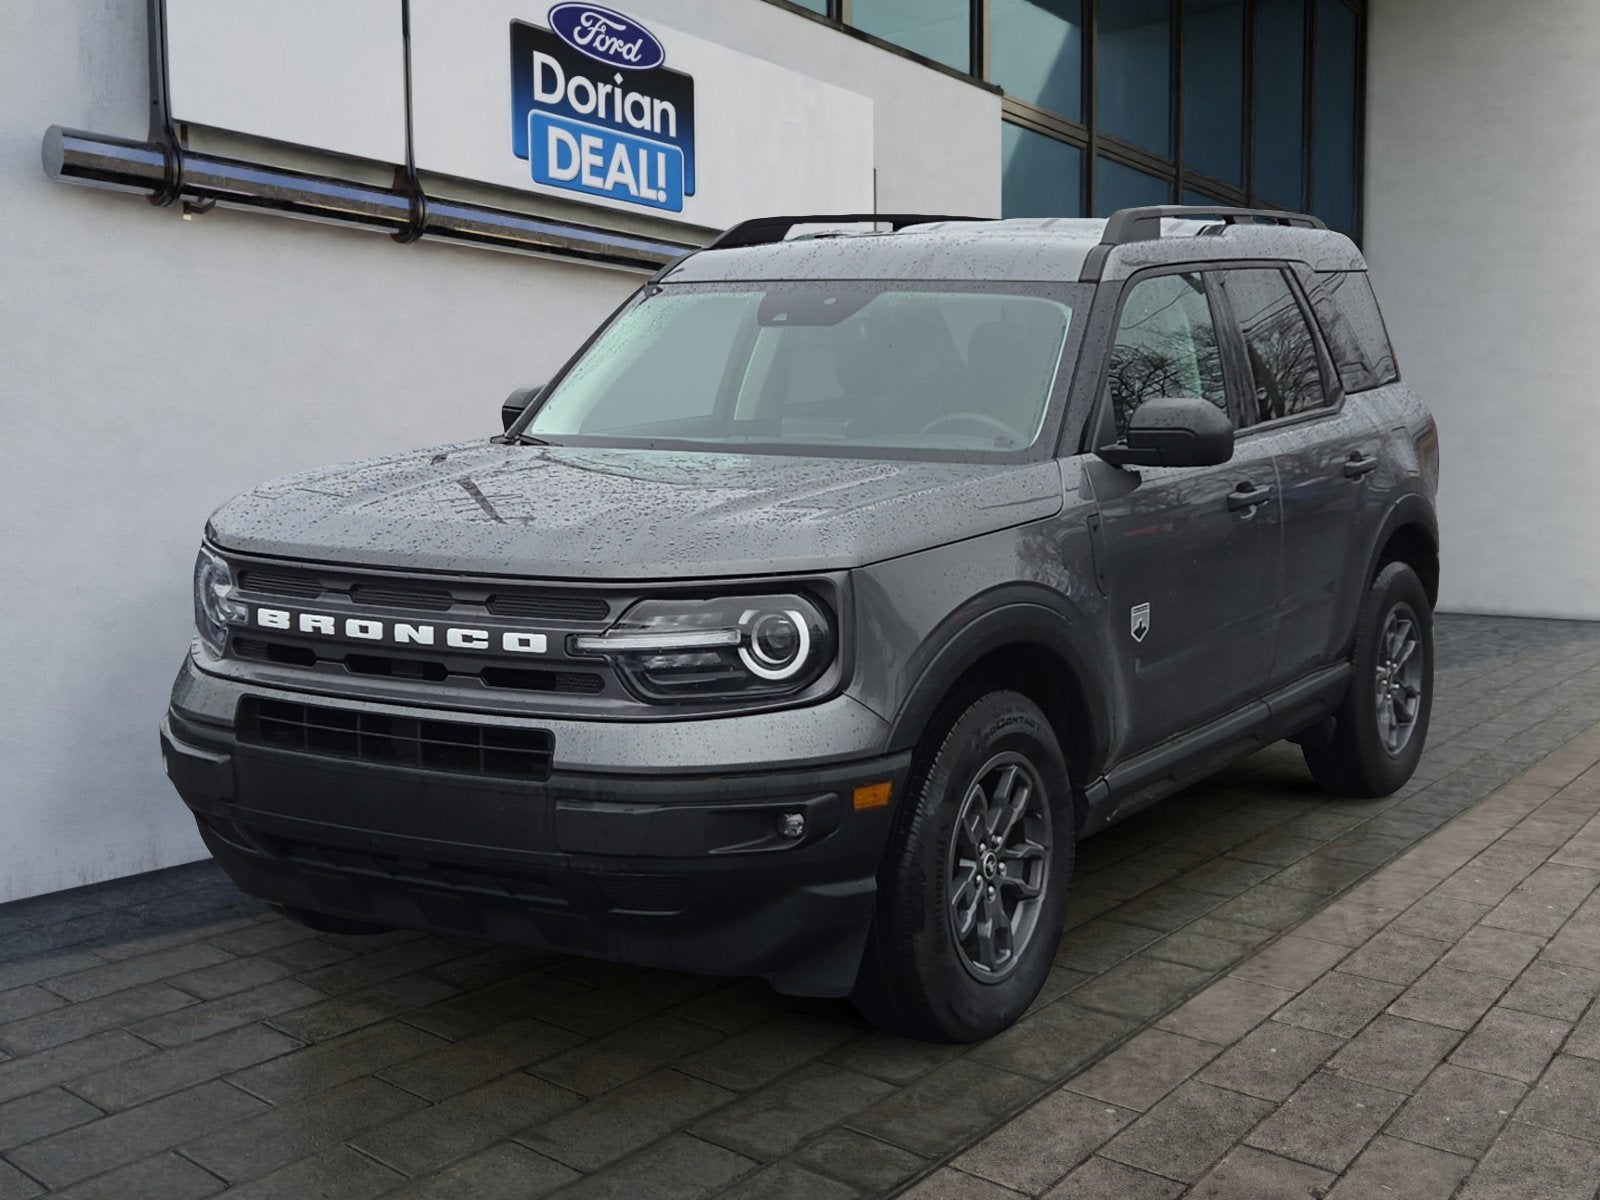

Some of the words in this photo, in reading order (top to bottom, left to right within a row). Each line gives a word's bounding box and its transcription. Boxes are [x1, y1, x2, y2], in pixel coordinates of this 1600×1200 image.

[573, 12, 643, 62] Ford
[533, 50, 677, 138] Dorian
[548, 125, 667, 204] DEAL!
[257, 608, 547, 653] BRONCO
